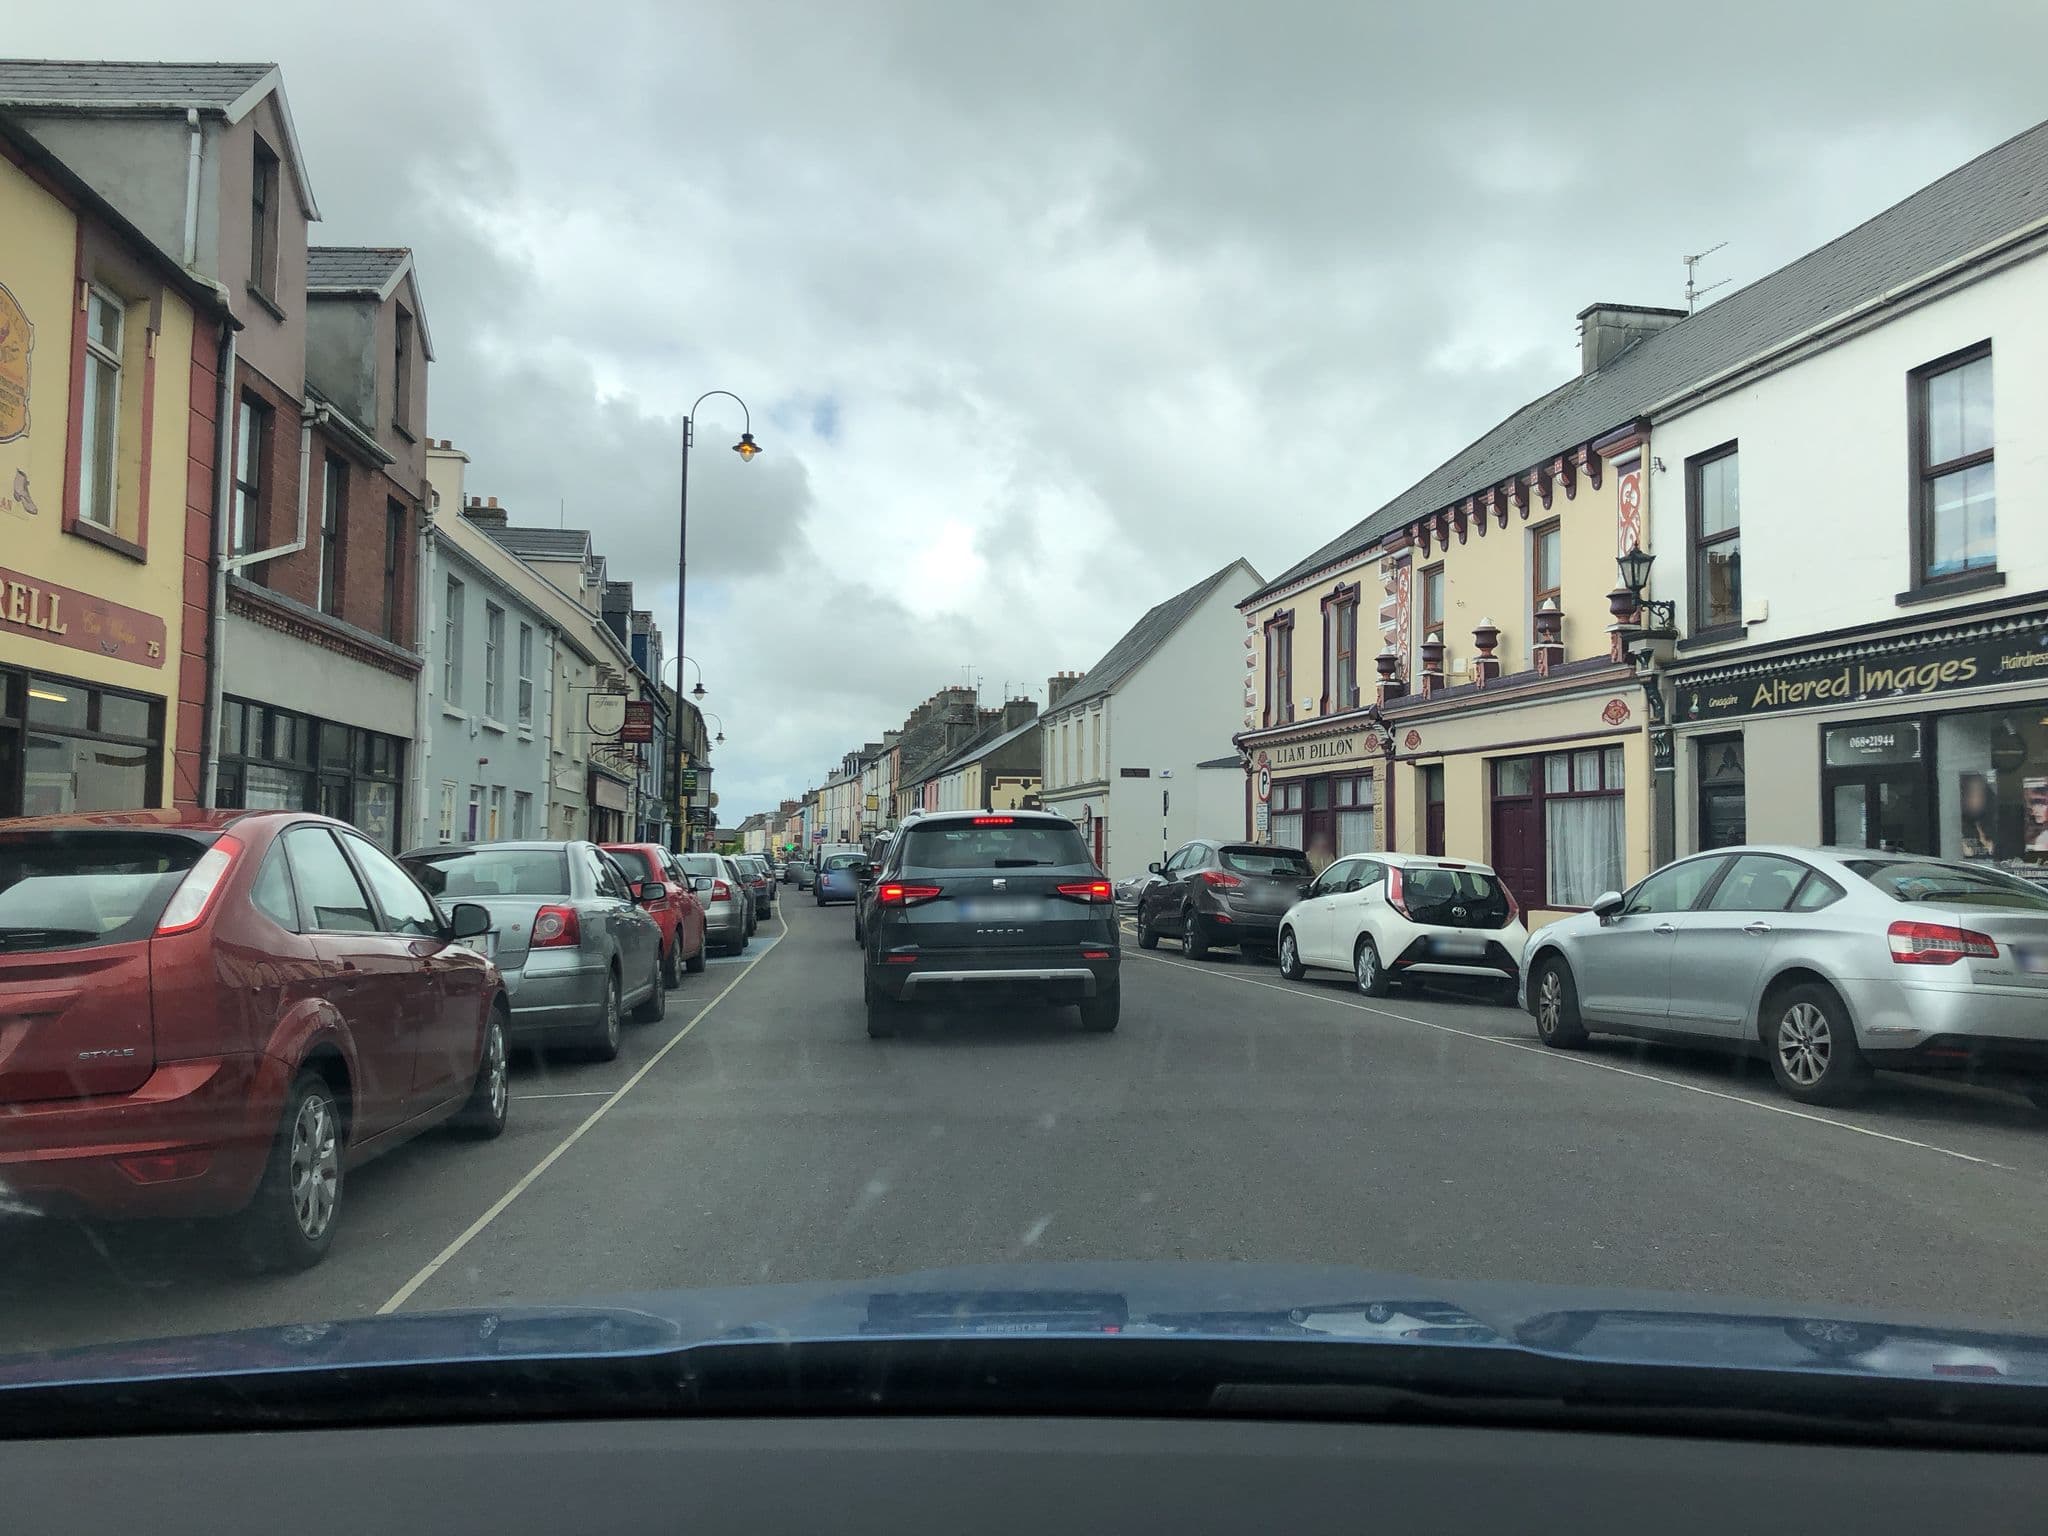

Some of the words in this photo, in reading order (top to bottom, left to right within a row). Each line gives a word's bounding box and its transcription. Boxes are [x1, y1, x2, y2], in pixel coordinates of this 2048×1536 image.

[0, 578, 68, 635] ELL
[147, 640, 160, 659] 75
[1752, 667, 1850, 709] Altered
[1859, 655, 1978, 693] Images
[1277, 746, 1305, 763] LIAM
[1310, 738, 1354, 759] DILLON
[1261, 771, 1268, 795] P
[79, 1048, 135, 1060] STYLE
